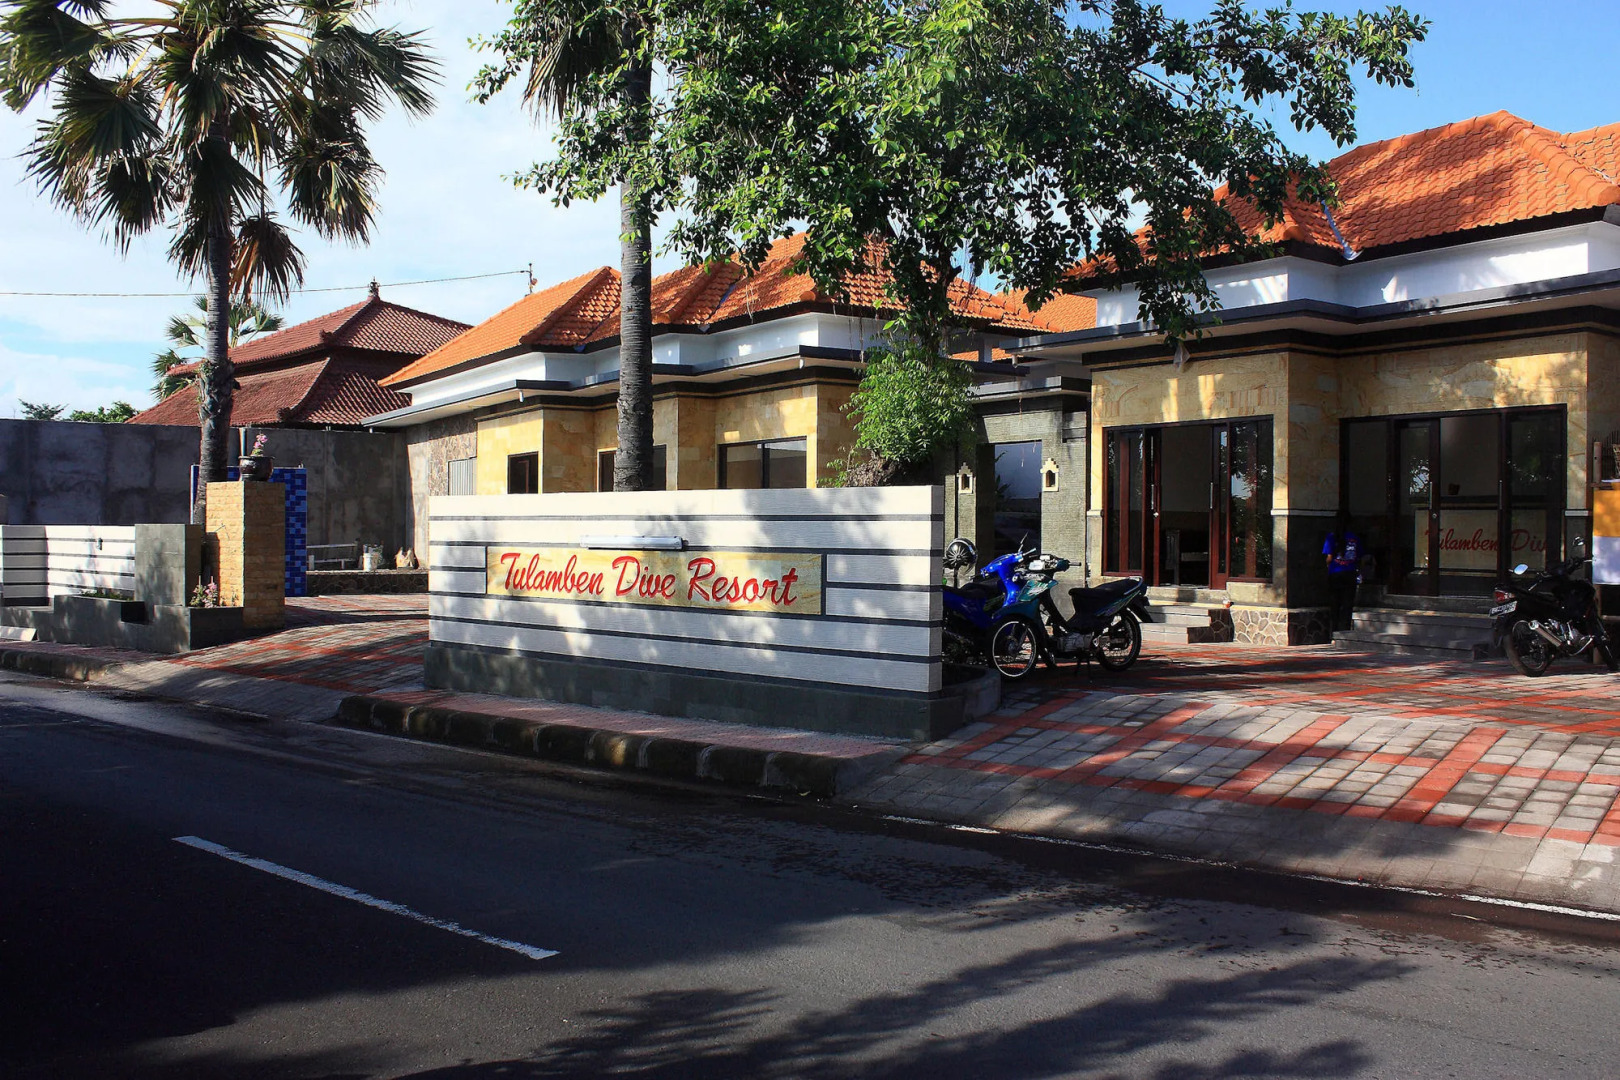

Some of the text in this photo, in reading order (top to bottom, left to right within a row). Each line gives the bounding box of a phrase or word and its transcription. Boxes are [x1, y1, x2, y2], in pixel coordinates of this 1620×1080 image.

[1425, 528, 1499, 551] ulamben
[500, 552, 799, 606] Tulamben Dive Resort
